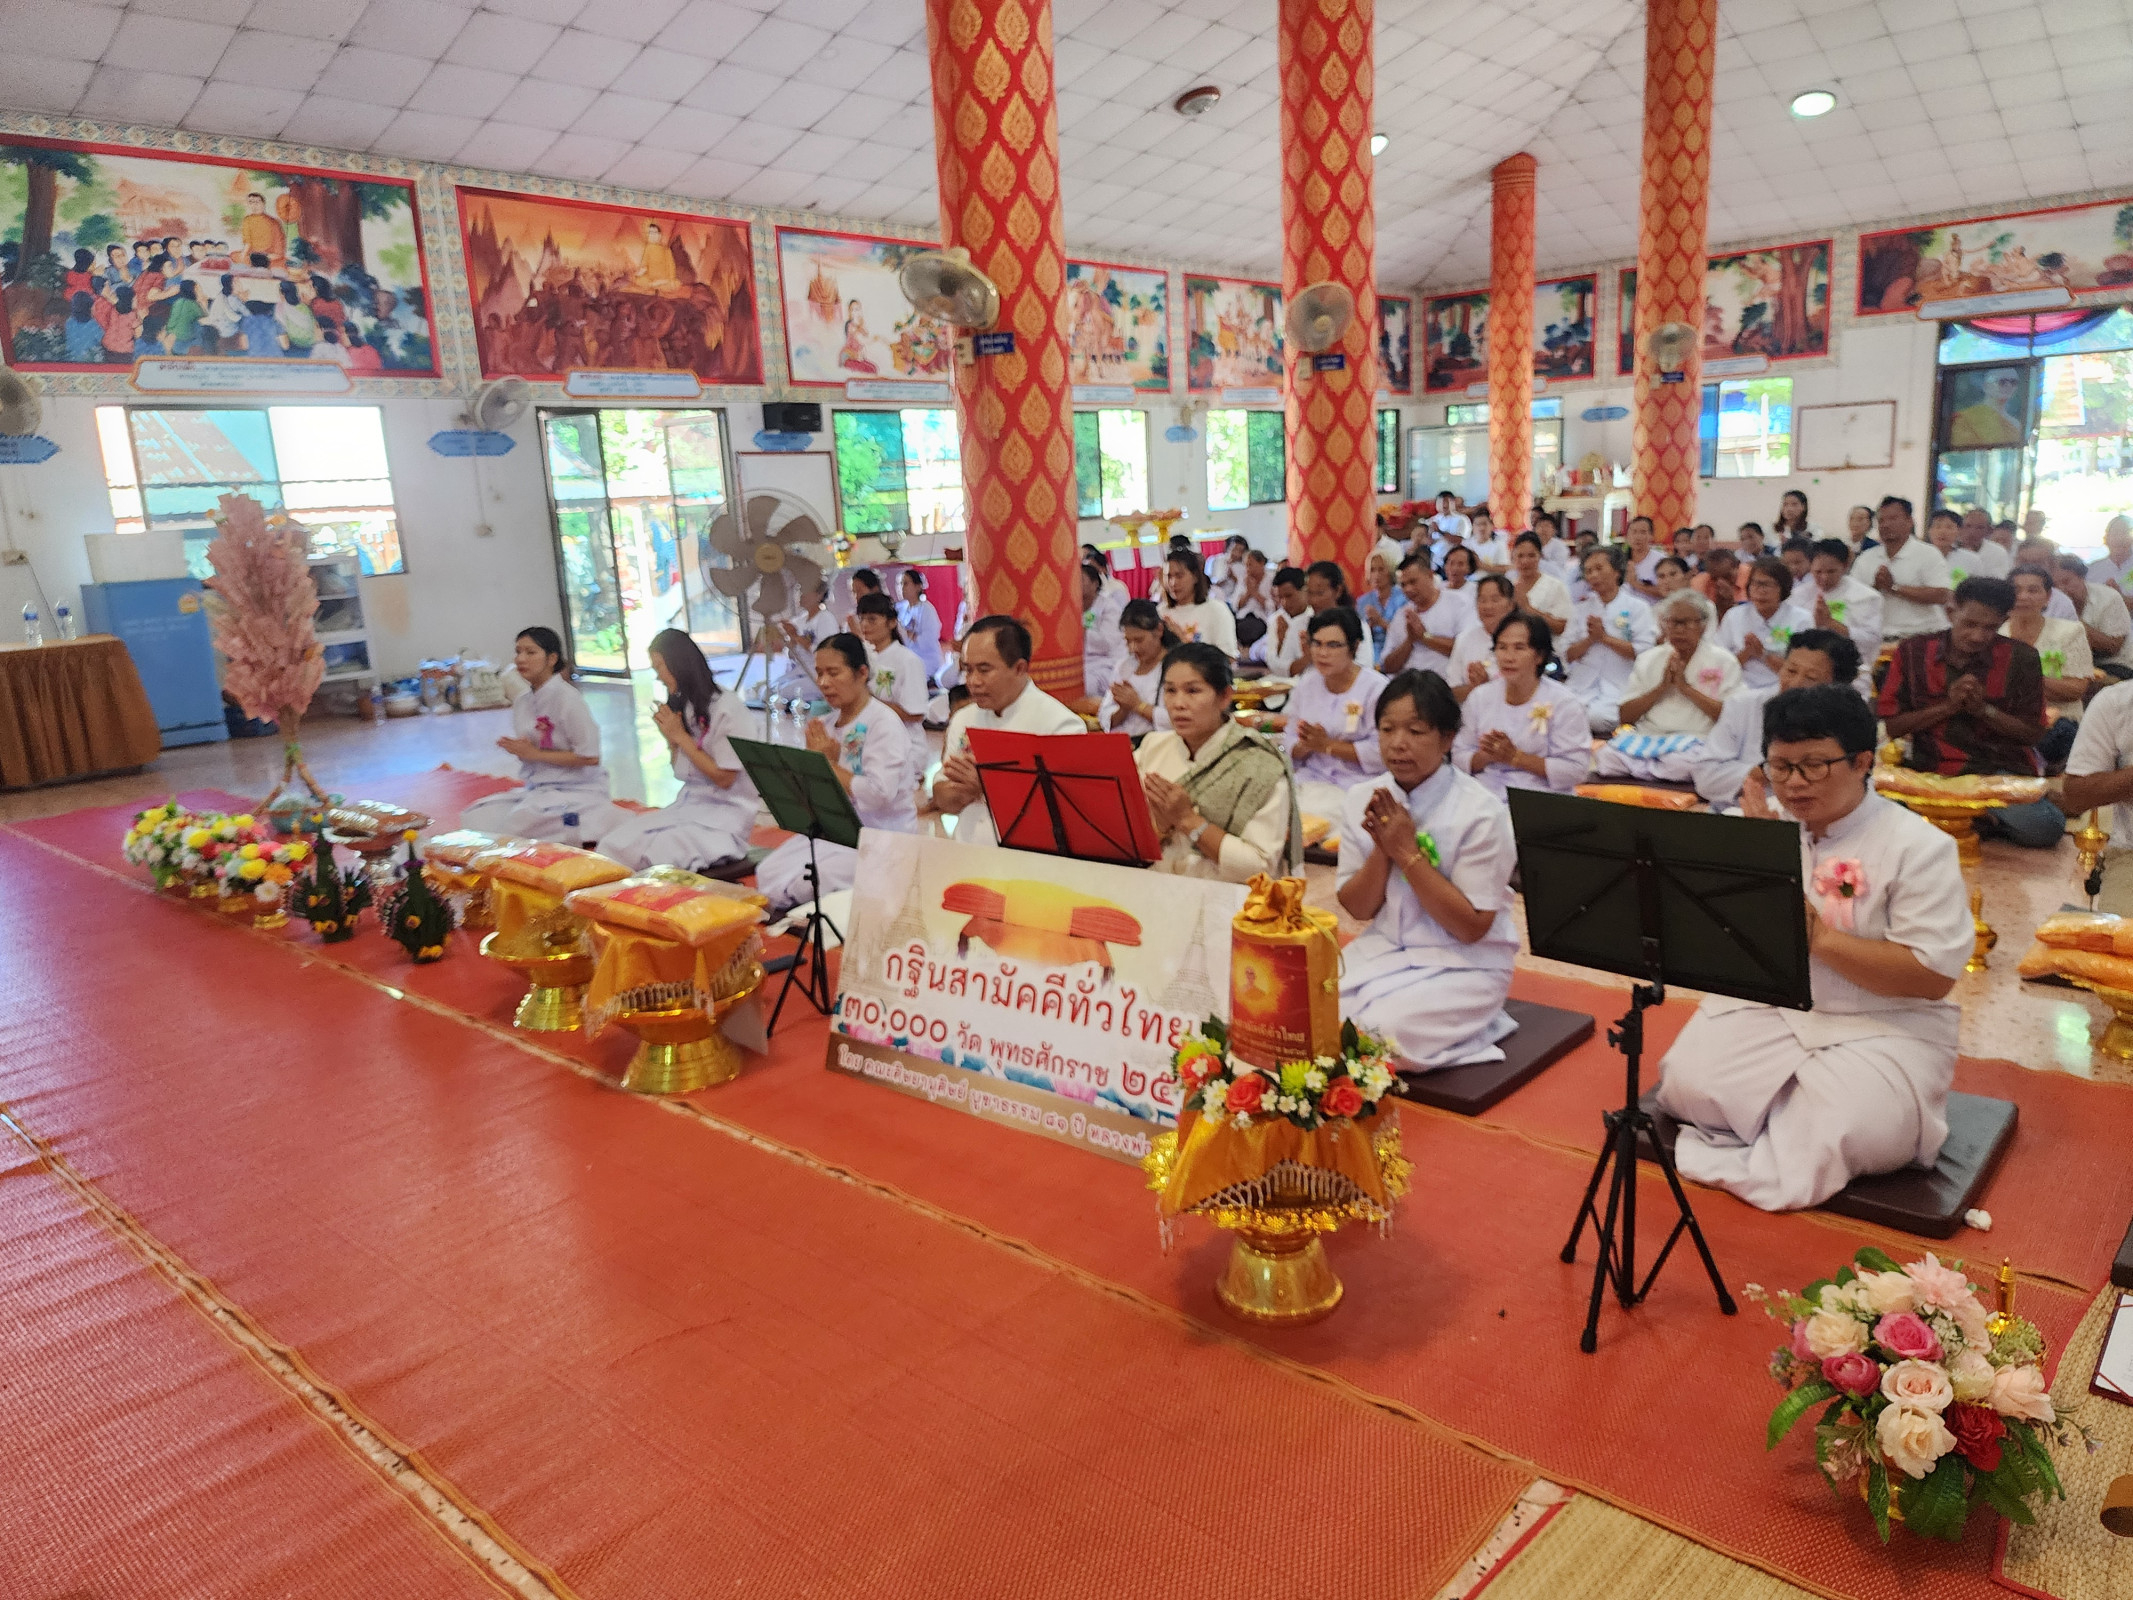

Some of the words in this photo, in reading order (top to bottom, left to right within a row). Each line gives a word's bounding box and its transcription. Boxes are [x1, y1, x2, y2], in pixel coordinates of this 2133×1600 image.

[957, 1021, 982, 1053] วัด
[990, 1036, 1109, 1086] พุทธศักราช
